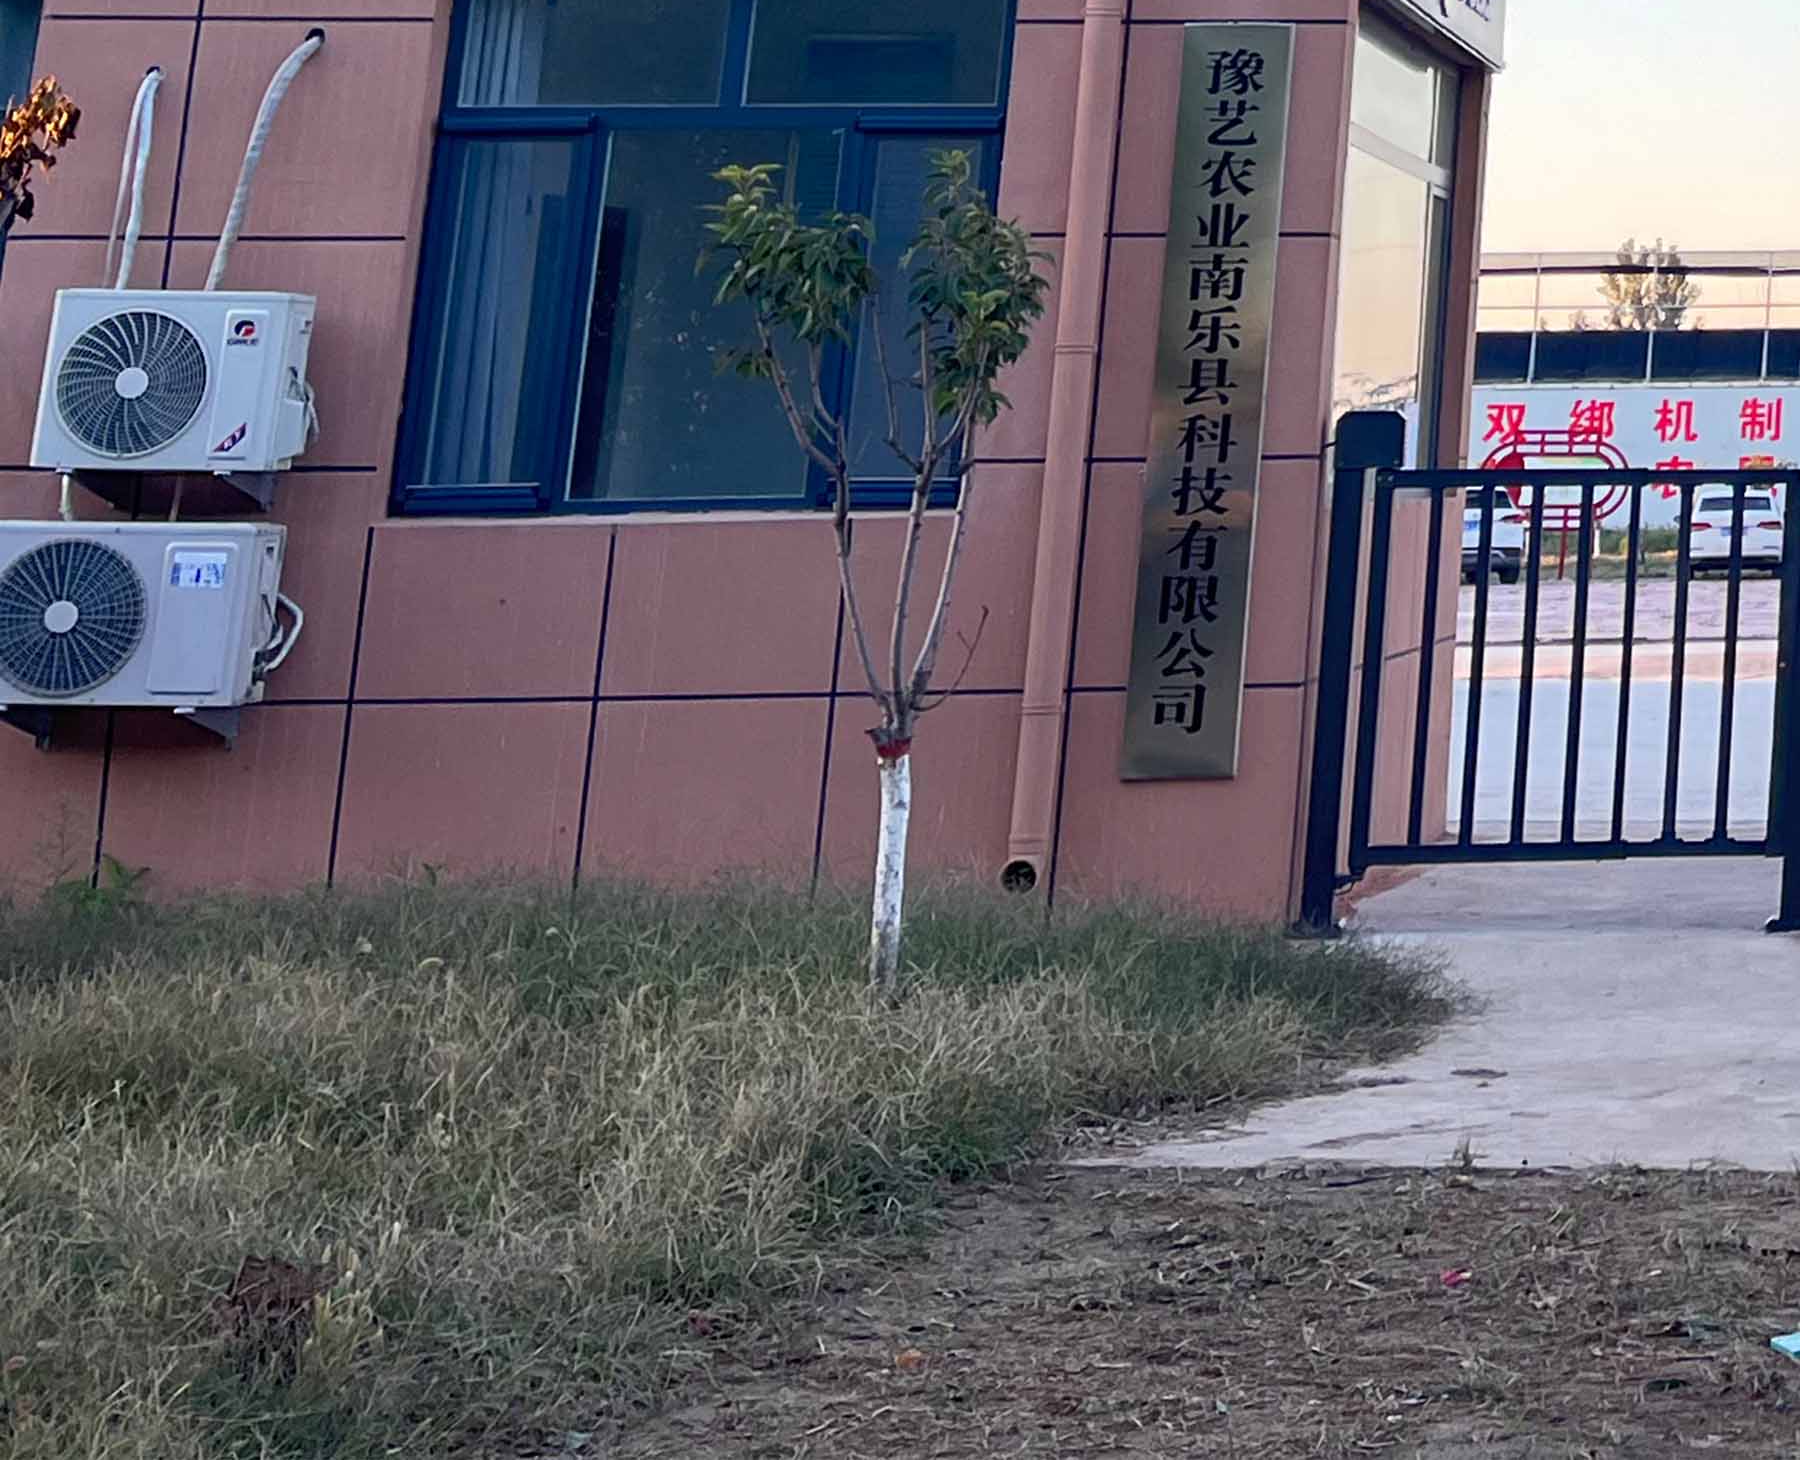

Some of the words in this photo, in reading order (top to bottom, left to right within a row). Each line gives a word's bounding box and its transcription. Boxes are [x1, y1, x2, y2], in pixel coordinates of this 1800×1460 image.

[1151, 47, 1265, 735] 豫艺农业南乐县科技有限公司
